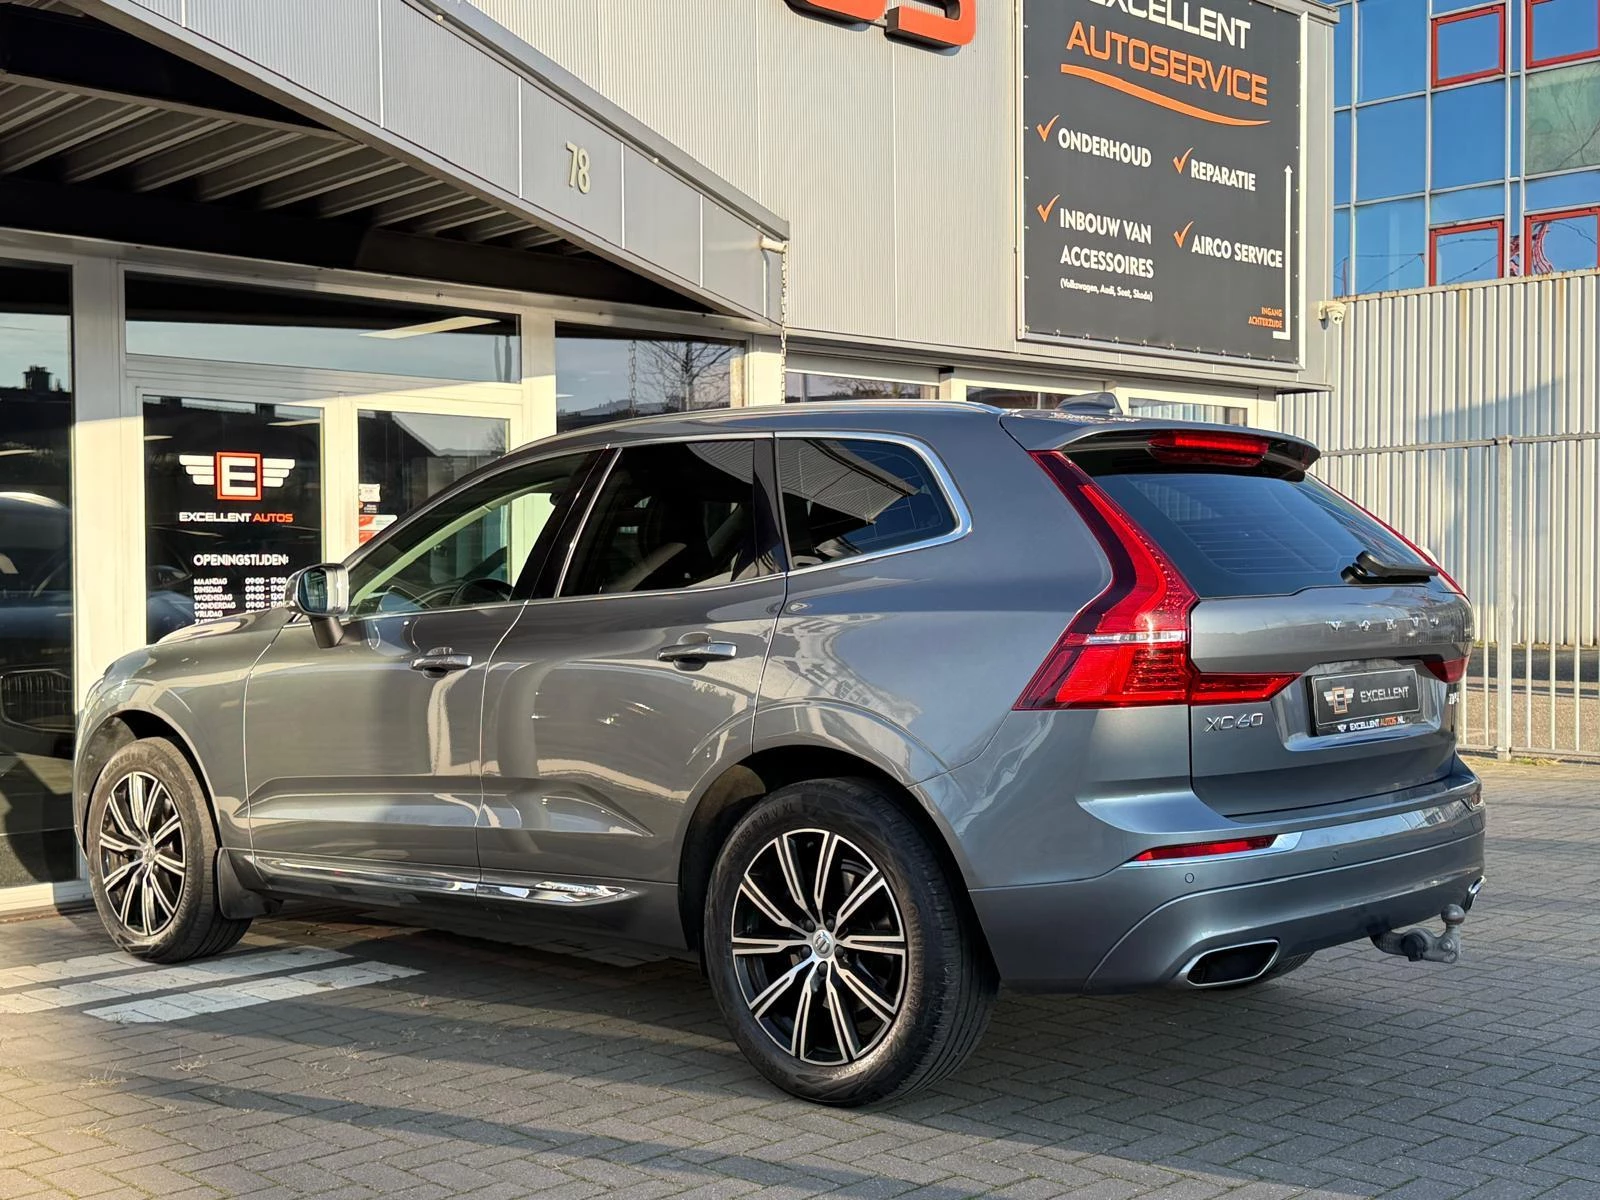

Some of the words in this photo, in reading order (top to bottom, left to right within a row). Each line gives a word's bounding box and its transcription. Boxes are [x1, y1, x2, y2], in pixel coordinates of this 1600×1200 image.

[1066, 21, 1268, 106] AUTOSERVICE
[1058, 128, 1152, 168] ONDERHOUD
[566, 141, 591, 195] 78
[1190, 159, 1256, 191] REPARATIE
[1060, 207, 1121, 238] INBOUW
[1123, 220, 1152, 245] VAN
[1060, 245, 1154, 279] ACCESSOIRES
[1191, 235, 1232, 259] AIRCO
[1234, 244, 1283, 268] SERVICE
[179, 512, 252, 523] EXCELLENT
[252, 513, 293, 523] AUTOS
[193, 577, 228, 585] MAANDAG
[193, 585, 223, 594] DINSDAG
[194, 593, 233, 602] WOENSDAG
[194, 601, 237, 610] DONDERDAG
[1360, 686, 1410, 703] EXCELLENT
[1204, 712, 1264, 733] XC60
